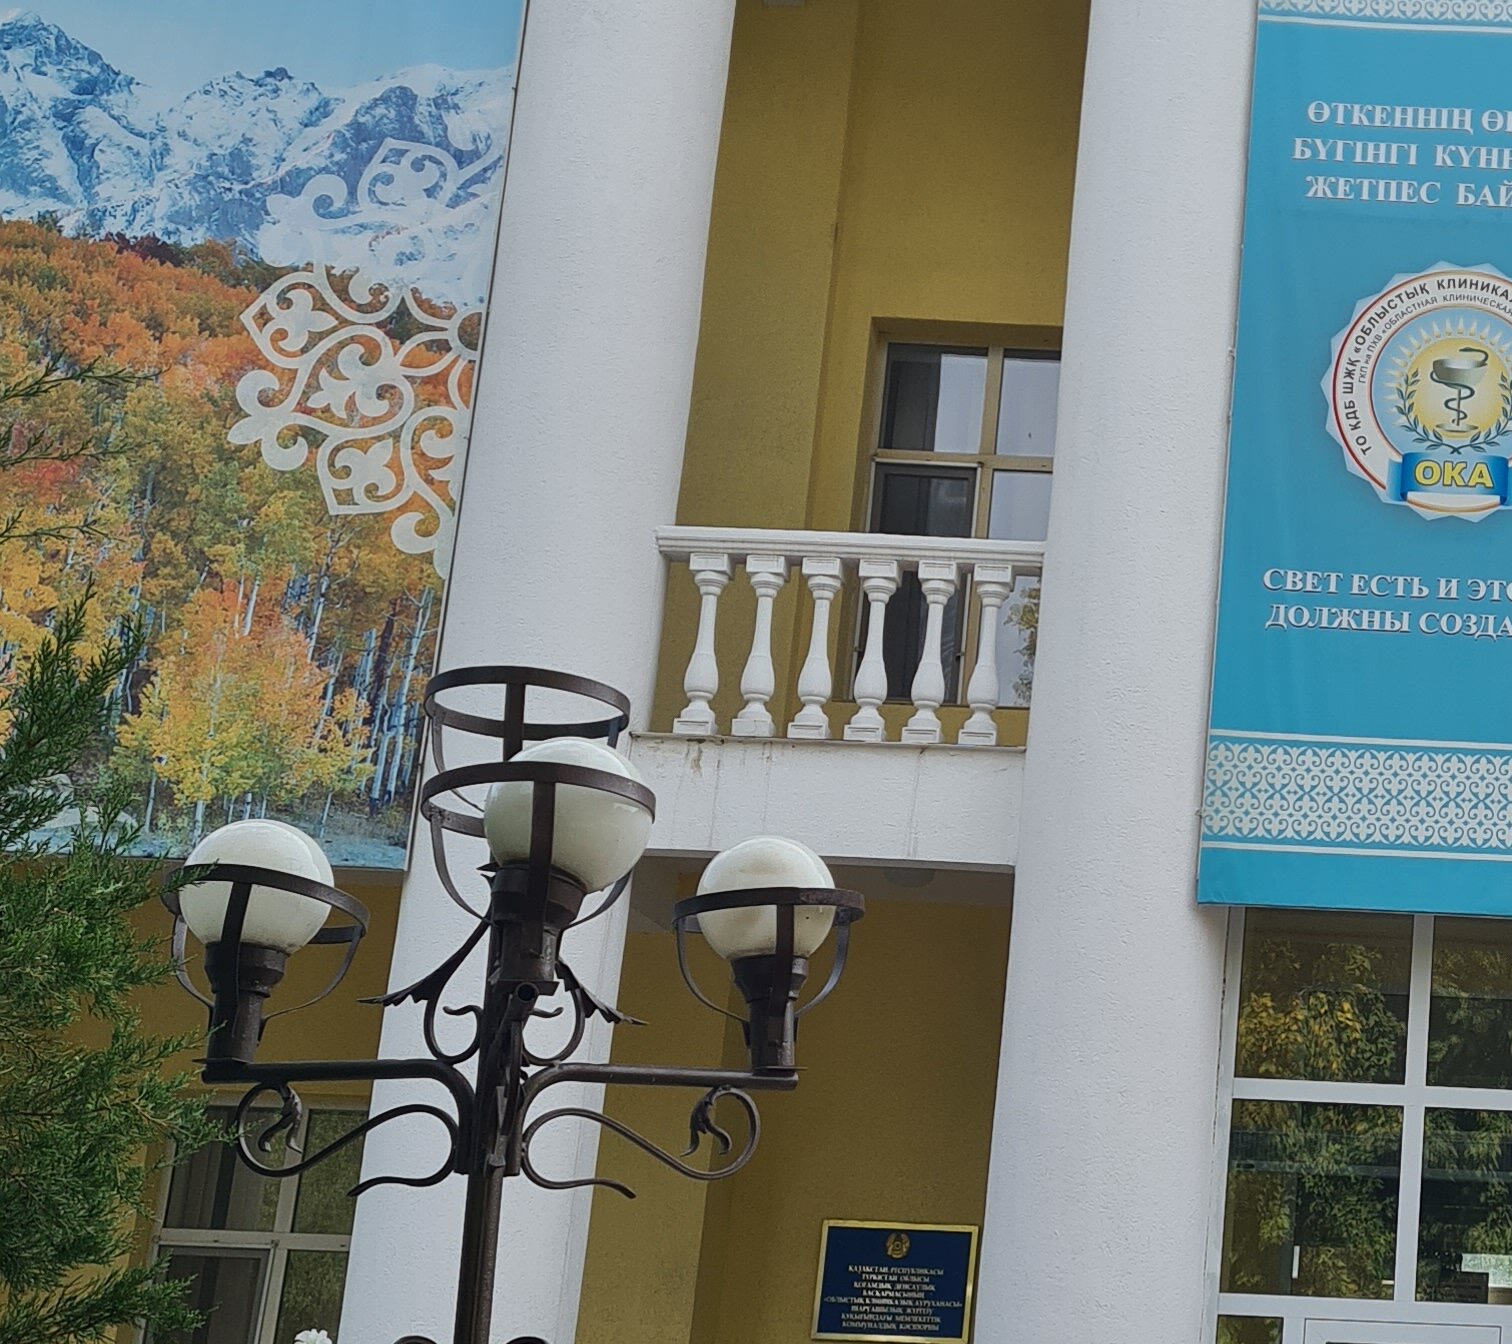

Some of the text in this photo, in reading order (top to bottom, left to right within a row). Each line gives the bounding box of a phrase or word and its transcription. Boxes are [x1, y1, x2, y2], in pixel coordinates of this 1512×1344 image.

[1306, 100, 1474, 135] ӨТКЕННІҢ
[1292, 138, 1417, 165] БҮГІНГІ
[1304, 176, 1440, 205] ЖЕТПЕС
[1356, 435, 1372, 456] ТО
[1414, 460, 1494, 488] ОКА
[1262, 568, 1343, 593] СВЕТ
[1350, 573, 1429, 598] ЕСТЬ
[1437, 577, 1460, 599] И
[1265, 604, 1411, 633] ДОЛЖНЫ
